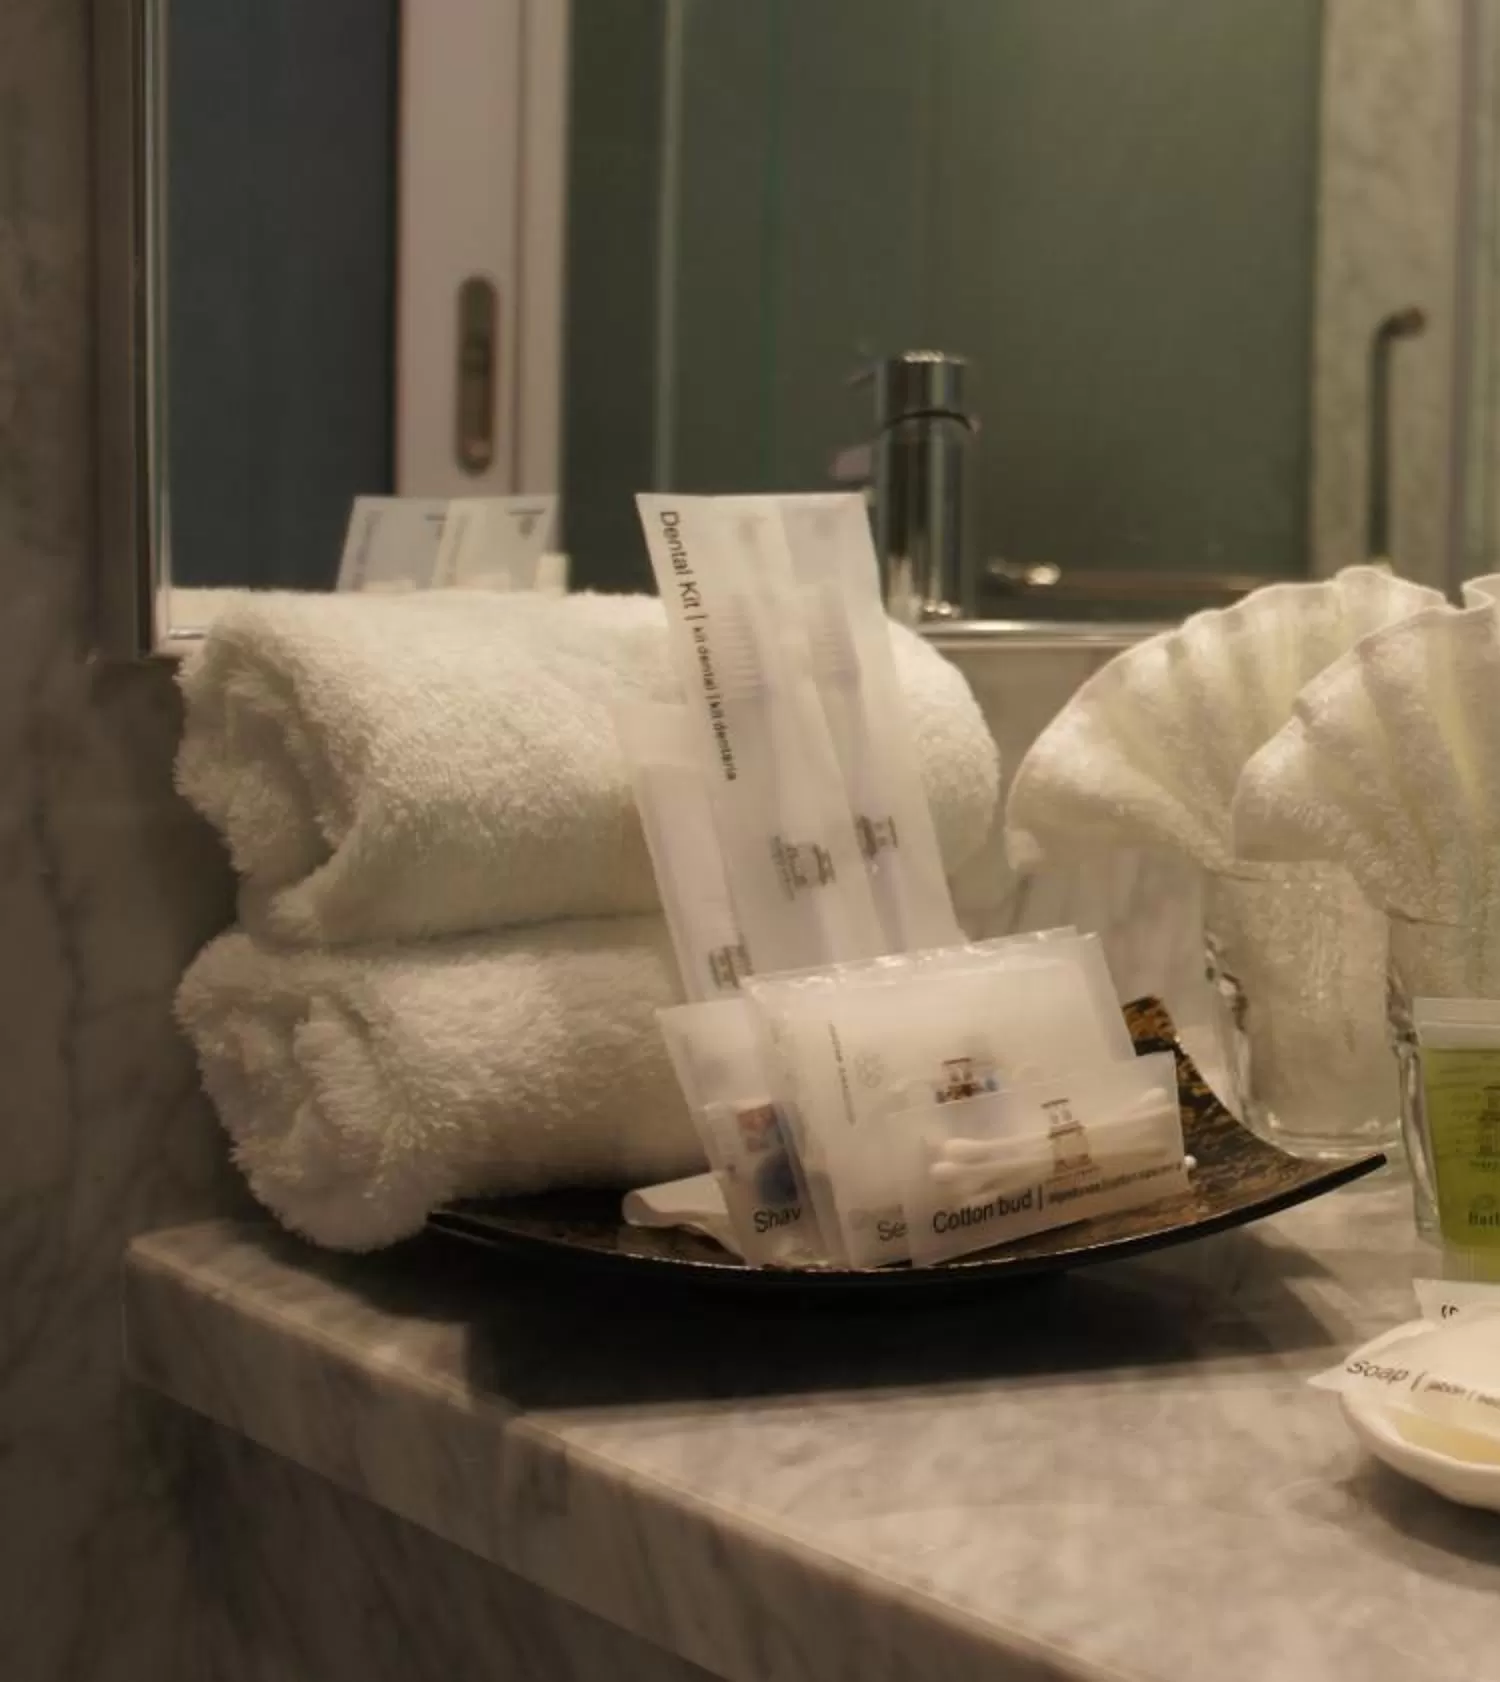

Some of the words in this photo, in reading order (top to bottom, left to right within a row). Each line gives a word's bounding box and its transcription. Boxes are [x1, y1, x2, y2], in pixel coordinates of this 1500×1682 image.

[660, 511, 694, 576] Dental
[677, 581, 702, 609] Kit
[932, 1204, 995, 1234] Cotton
[997, 1187, 1034, 1217] bud
[1346, 1360, 1409, 1385] Soap
